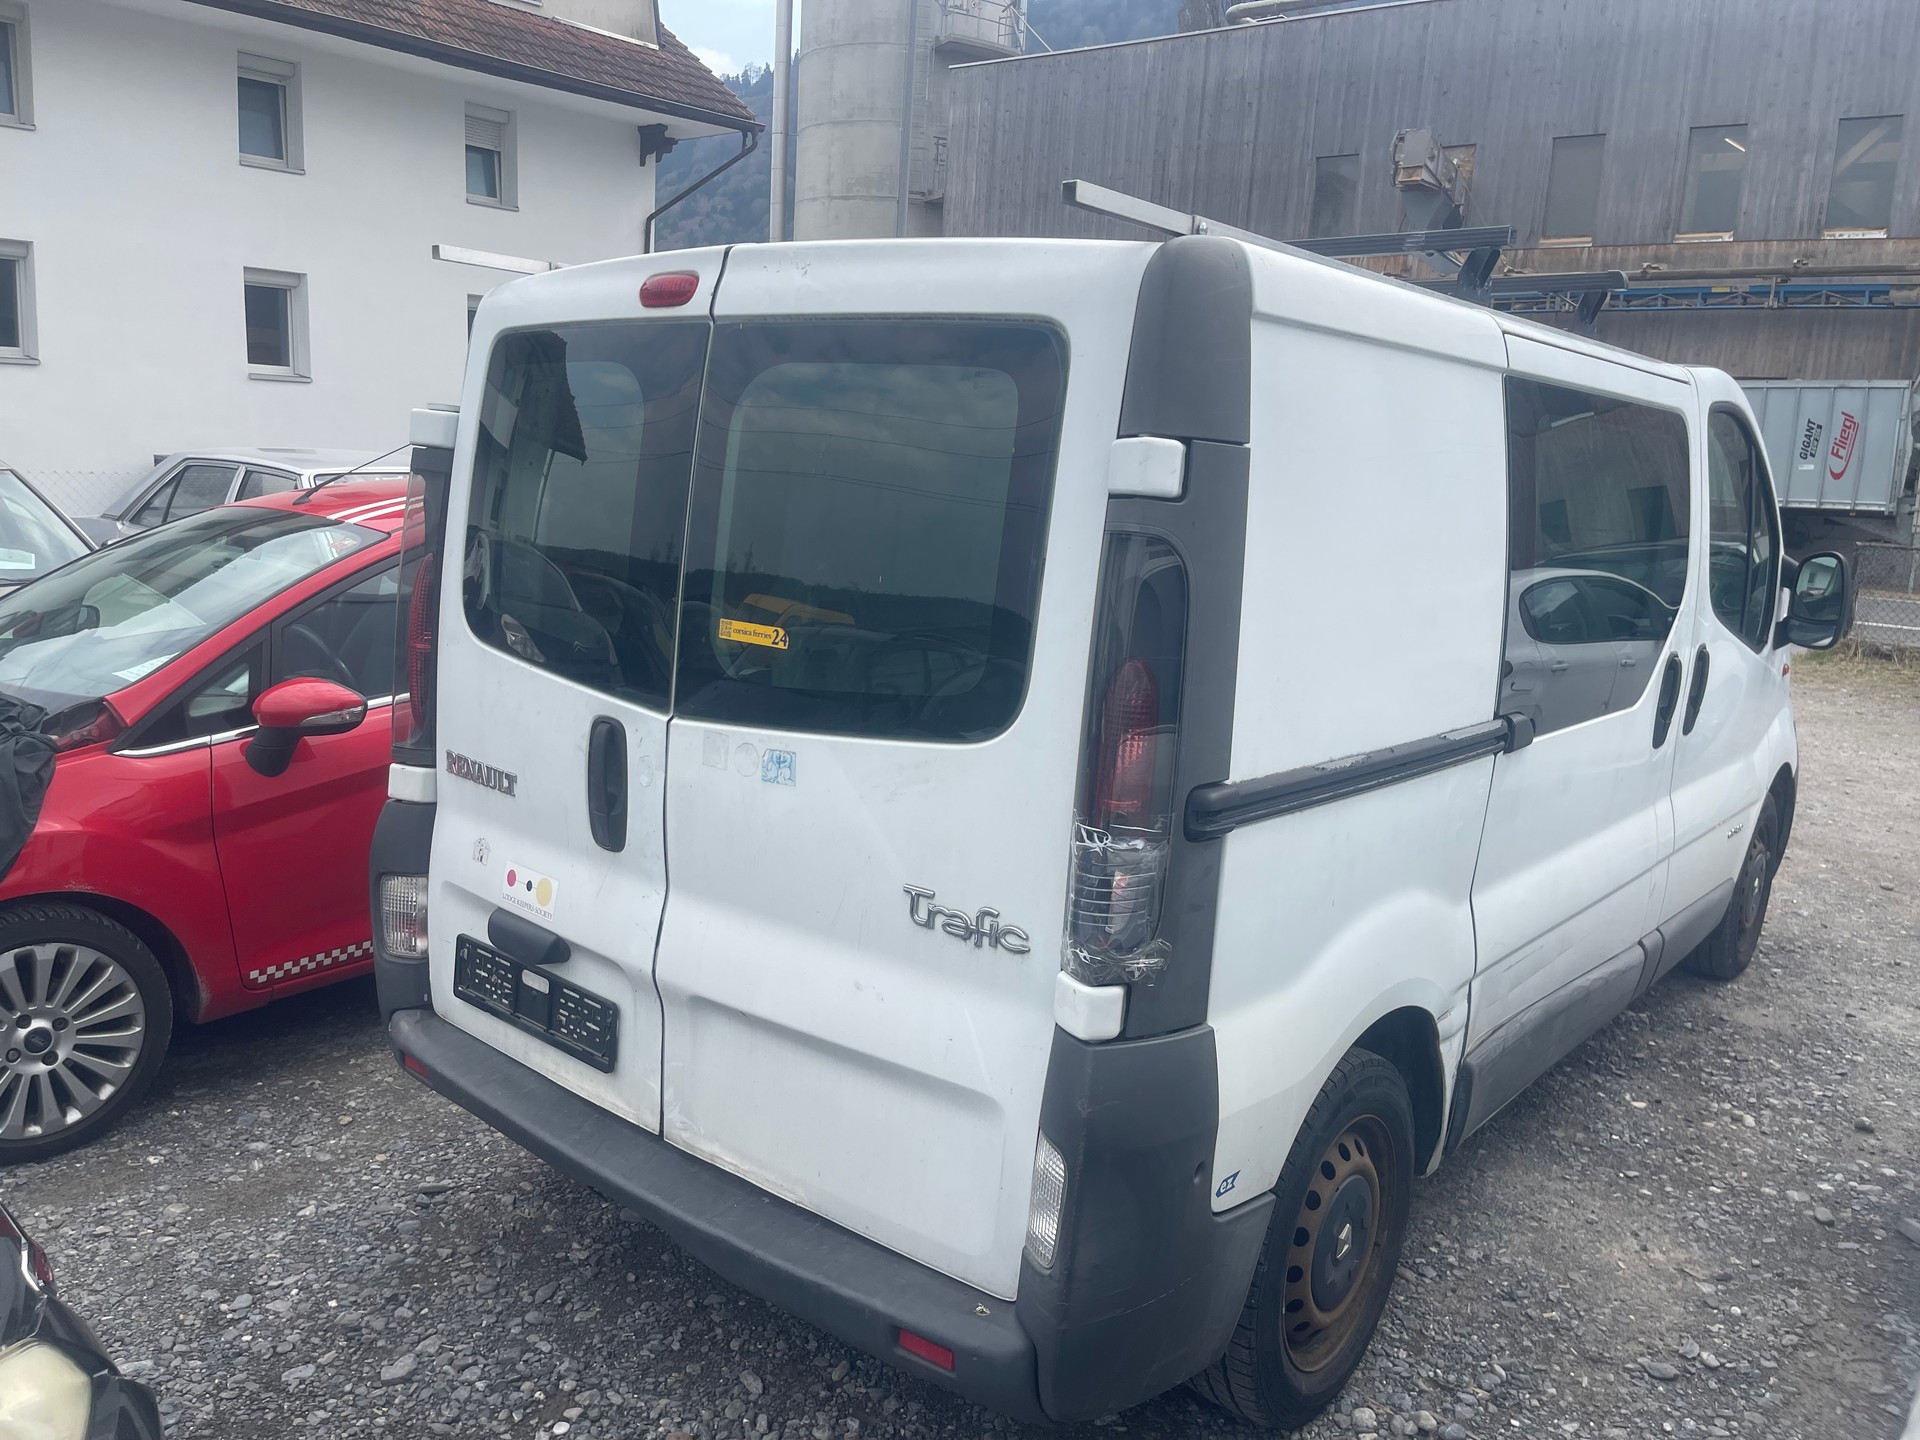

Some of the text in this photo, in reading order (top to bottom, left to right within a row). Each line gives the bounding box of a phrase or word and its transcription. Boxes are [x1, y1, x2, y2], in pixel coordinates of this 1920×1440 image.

[1799, 418, 1816, 460] GIGANT
[1830, 411, 1857, 461] Fliegl
[733, 627, 788, 647] corsica ferries 24
[446, 749, 518, 798] RENAULT
[502, 892, 516, 905] LODGE
[534, 906, 553, 920] SOCIETY
[903, 883, 1031, 954] Trafic
